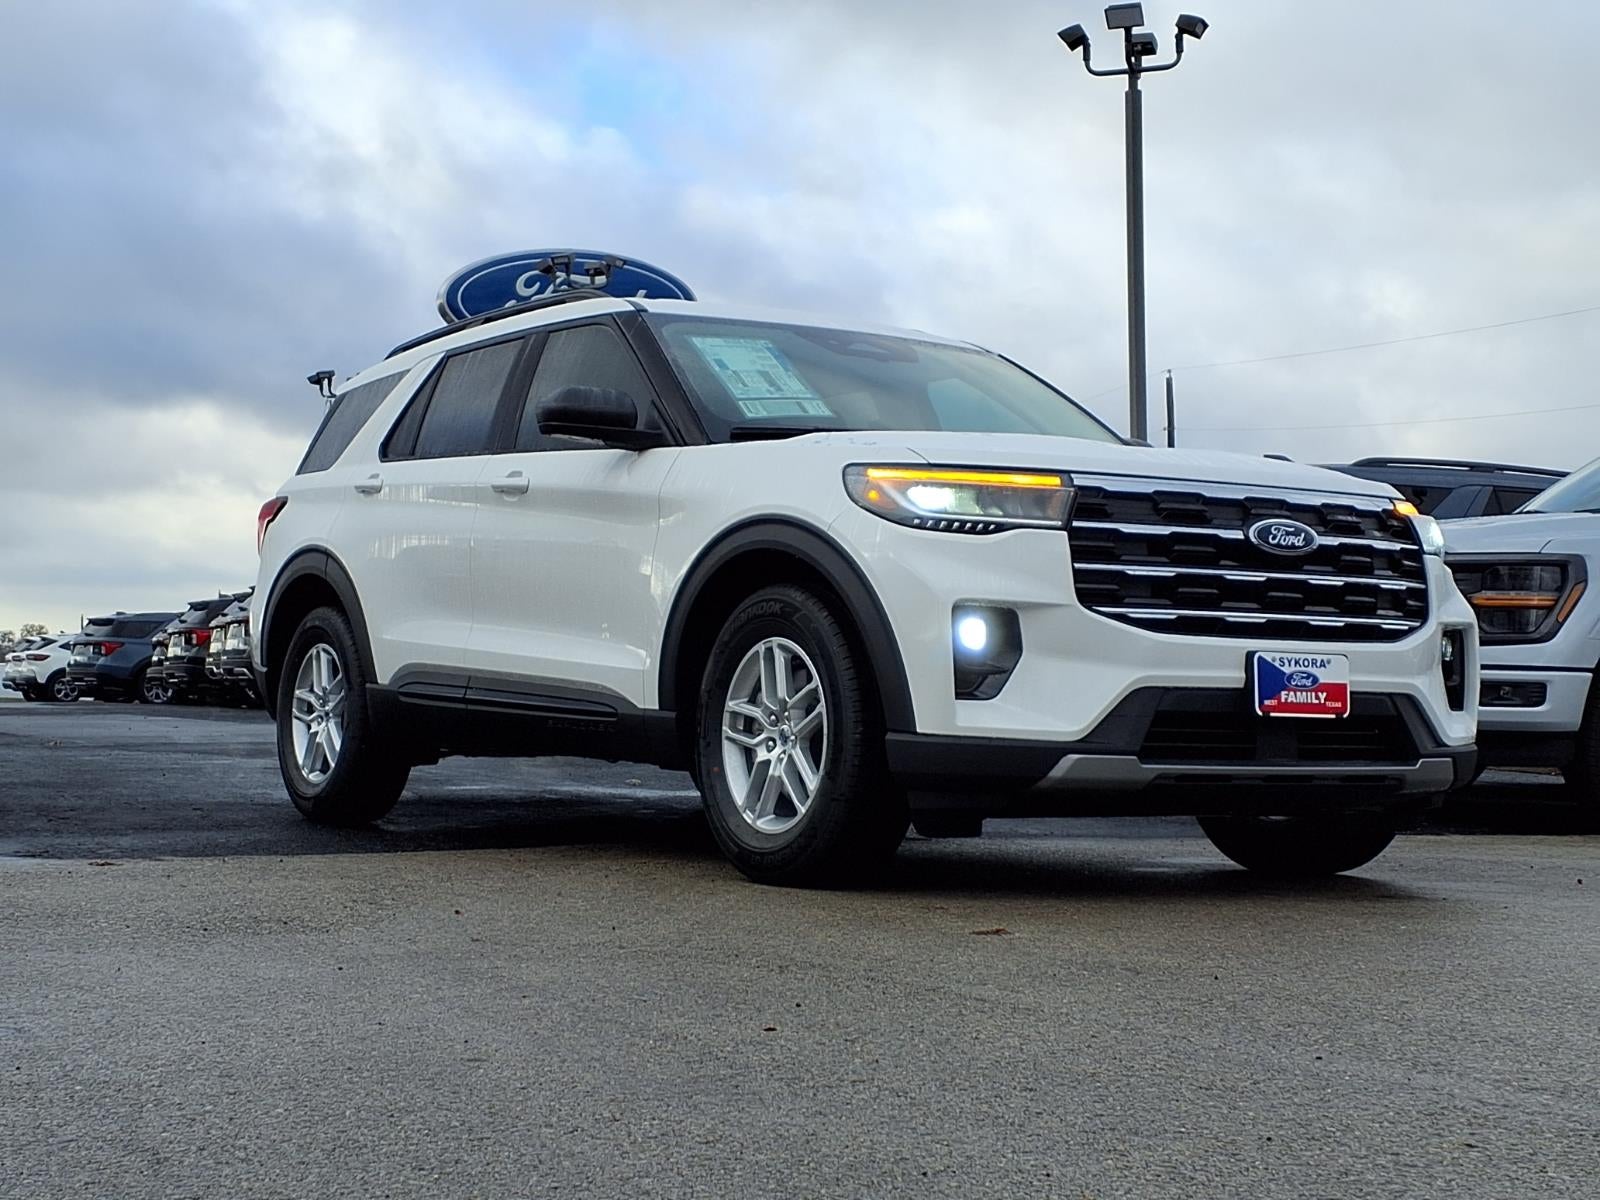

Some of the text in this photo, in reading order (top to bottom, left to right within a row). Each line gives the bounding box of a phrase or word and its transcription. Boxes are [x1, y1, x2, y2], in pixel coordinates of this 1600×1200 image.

[1268, 525, 1306, 547] Ford
[1278, 656, 1327, 669] SYKORA
[1290, 672, 1314, 686] Ford
[1280, 691, 1327, 704] FAMILY
